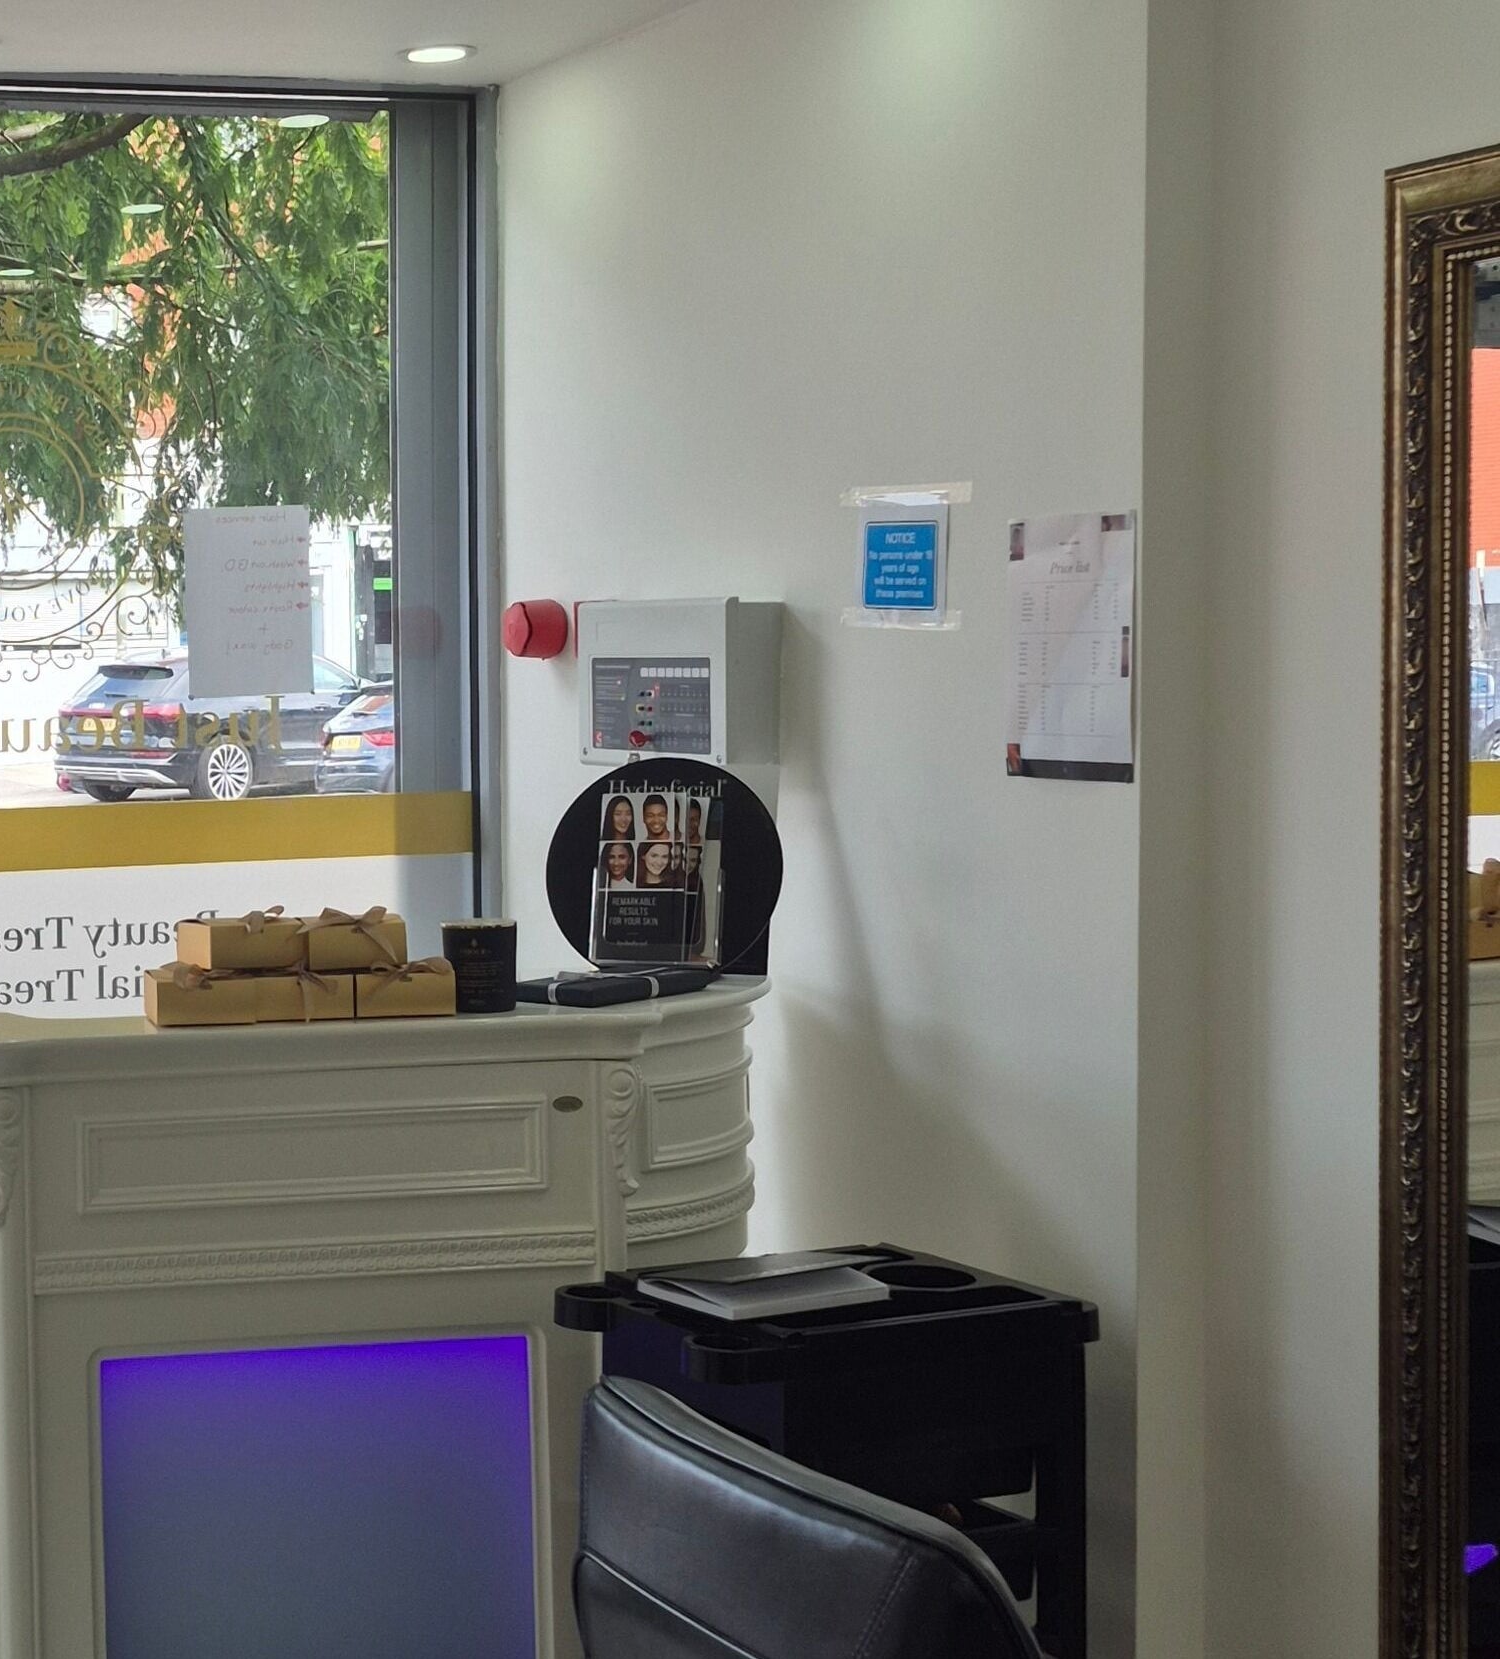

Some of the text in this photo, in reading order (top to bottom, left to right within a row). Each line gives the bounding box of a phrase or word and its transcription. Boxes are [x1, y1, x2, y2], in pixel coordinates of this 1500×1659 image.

[885, 532, 916, 544] NOTICE
[612, 897, 656, 907] REMARKABLE
[619, 906, 648, 916] RESULTS
[609, 916, 659, 926] FOR YOUR SKIN
